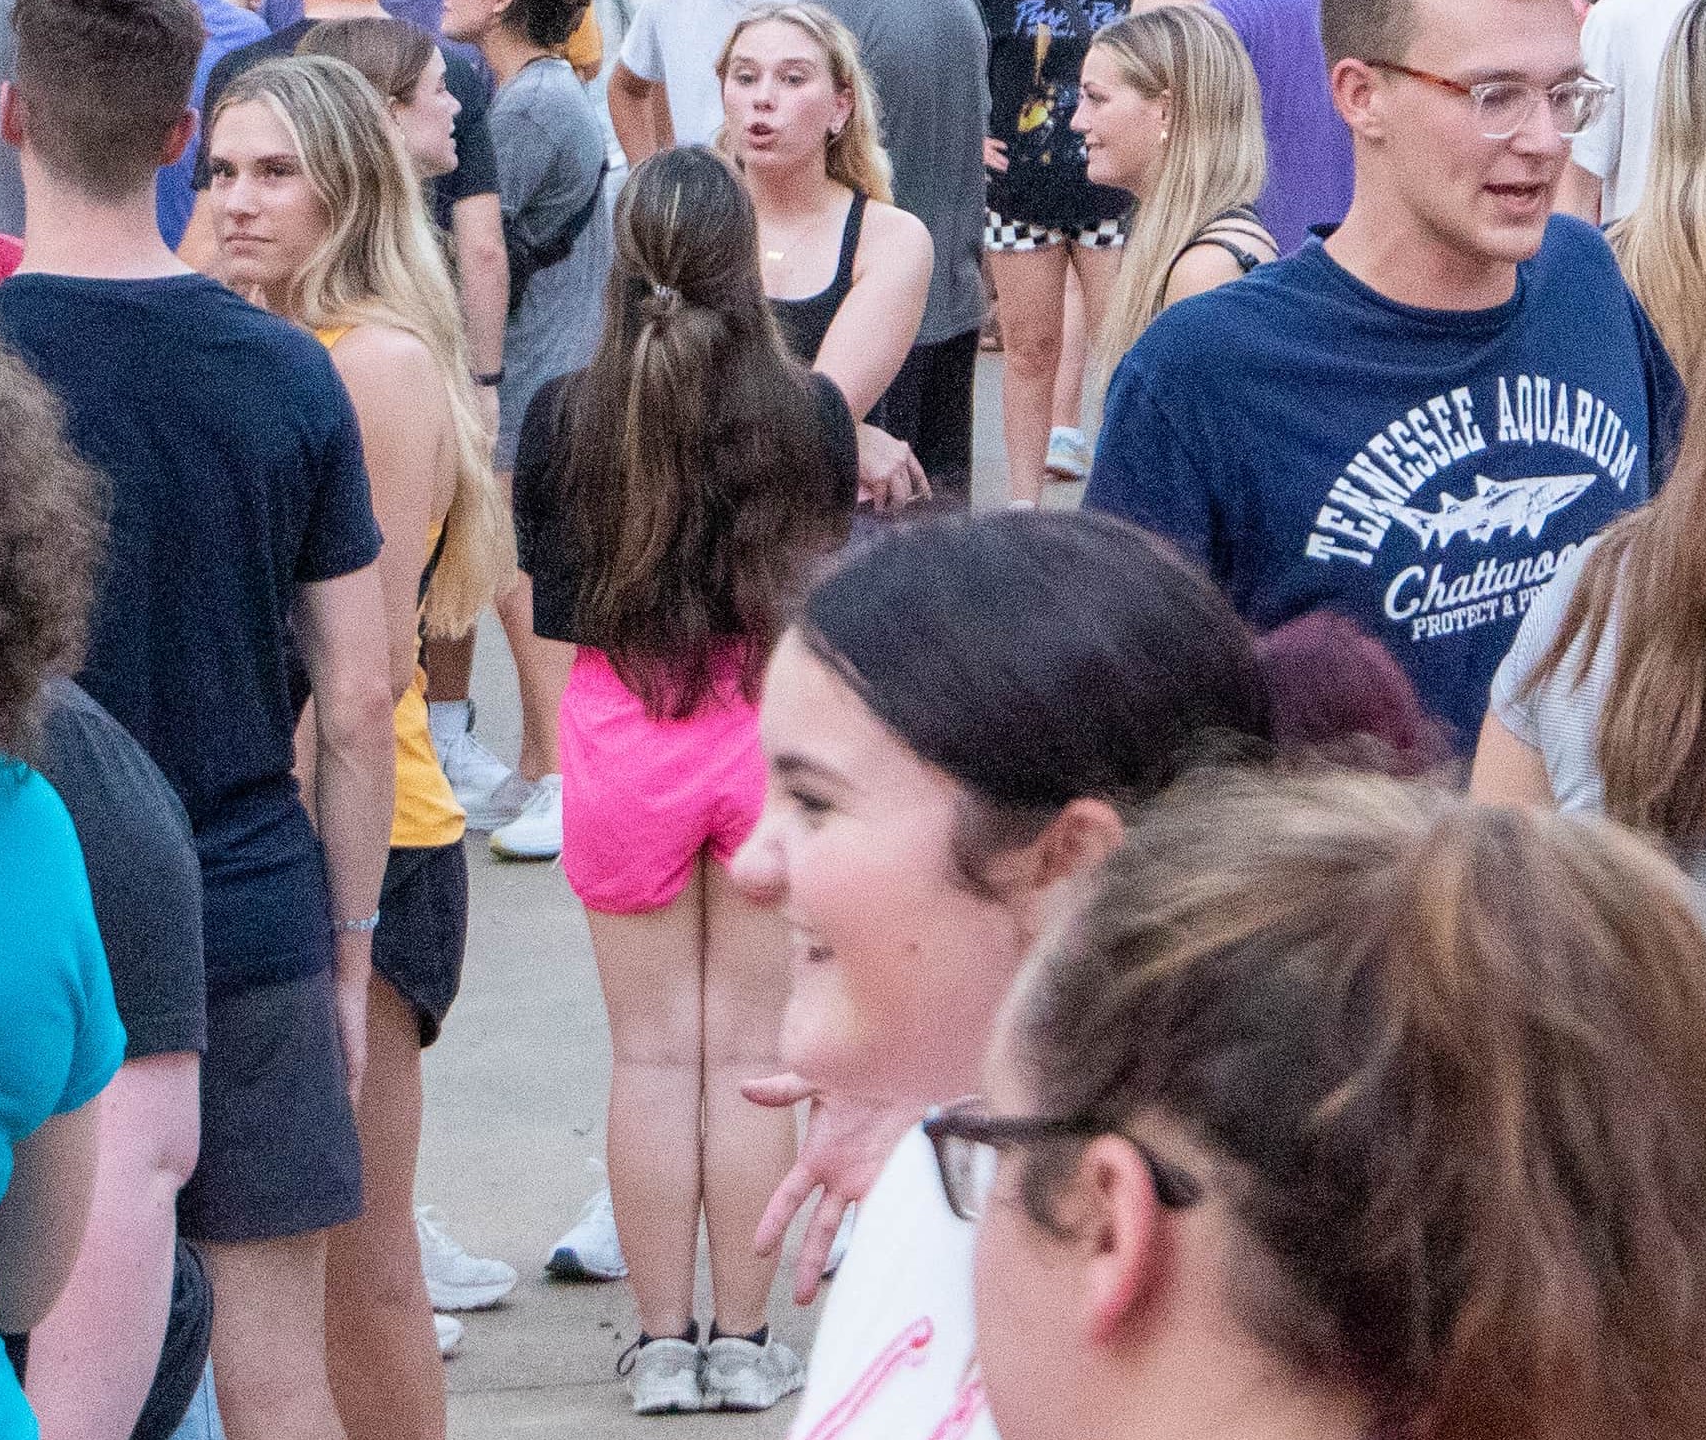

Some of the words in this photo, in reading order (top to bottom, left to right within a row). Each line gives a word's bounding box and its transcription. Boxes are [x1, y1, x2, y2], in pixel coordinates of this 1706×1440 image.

[1305, 385, 1488, 566] TENNESSEE
[1496, 375, 1638, 490] AQUARIUM
[1383, 542, 1579, 622] Chattanoo
[1412, 596, 1499, 642] PROTECT
[1502, 594, 1515, 616] &
